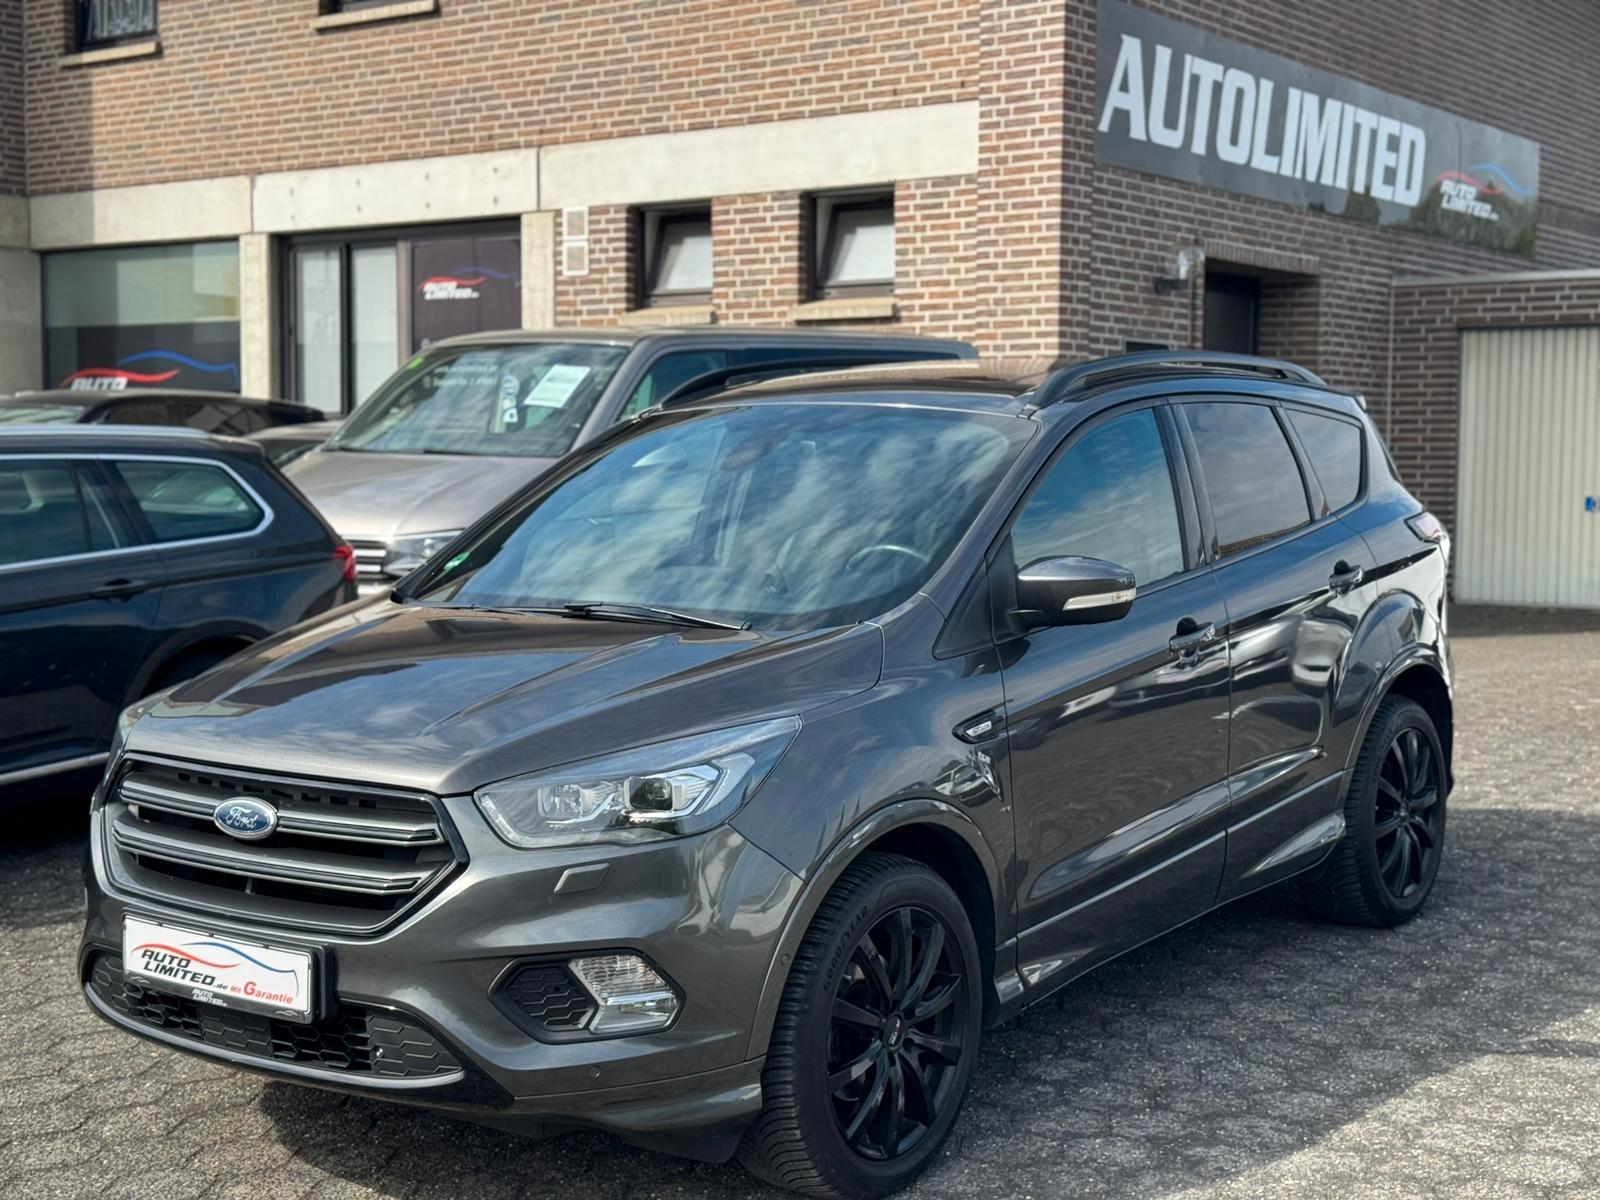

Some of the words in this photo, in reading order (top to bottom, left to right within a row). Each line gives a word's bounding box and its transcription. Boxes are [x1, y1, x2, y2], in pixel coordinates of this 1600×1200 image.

[1098, 34, 1426, 207] AUTOLIMITED
[1440, 179, 1477, 201] AUTO
[70, 376, 128, 392] AUTO
[225, 806, 259, 829] Ford
[141, 949, 191, 968] AUTO
[192, 988, 213, 998] AUTO
[230, 985, 241, 993] Mit
[243, 981, 293, 1004] Garantie
